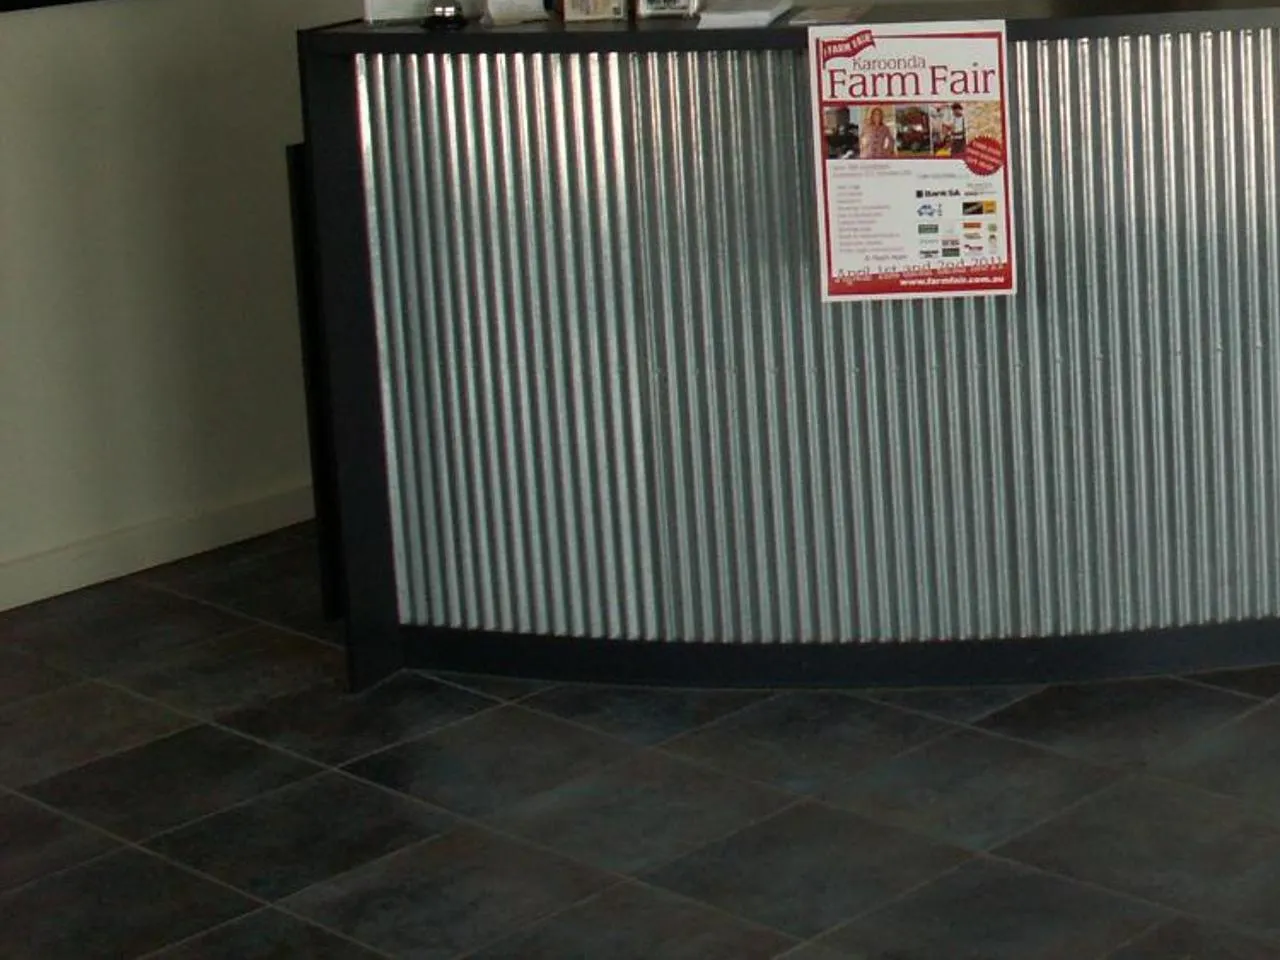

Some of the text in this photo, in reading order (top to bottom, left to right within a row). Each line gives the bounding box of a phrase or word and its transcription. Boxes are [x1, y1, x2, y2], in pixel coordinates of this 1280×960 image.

[852, 55, 927, 71] Karoonda
[828, 62, 996, 99] Farm Fair
[834, 265, 871, 286] April
[899, 275, 1005, 287] www.farmfair.com.au
